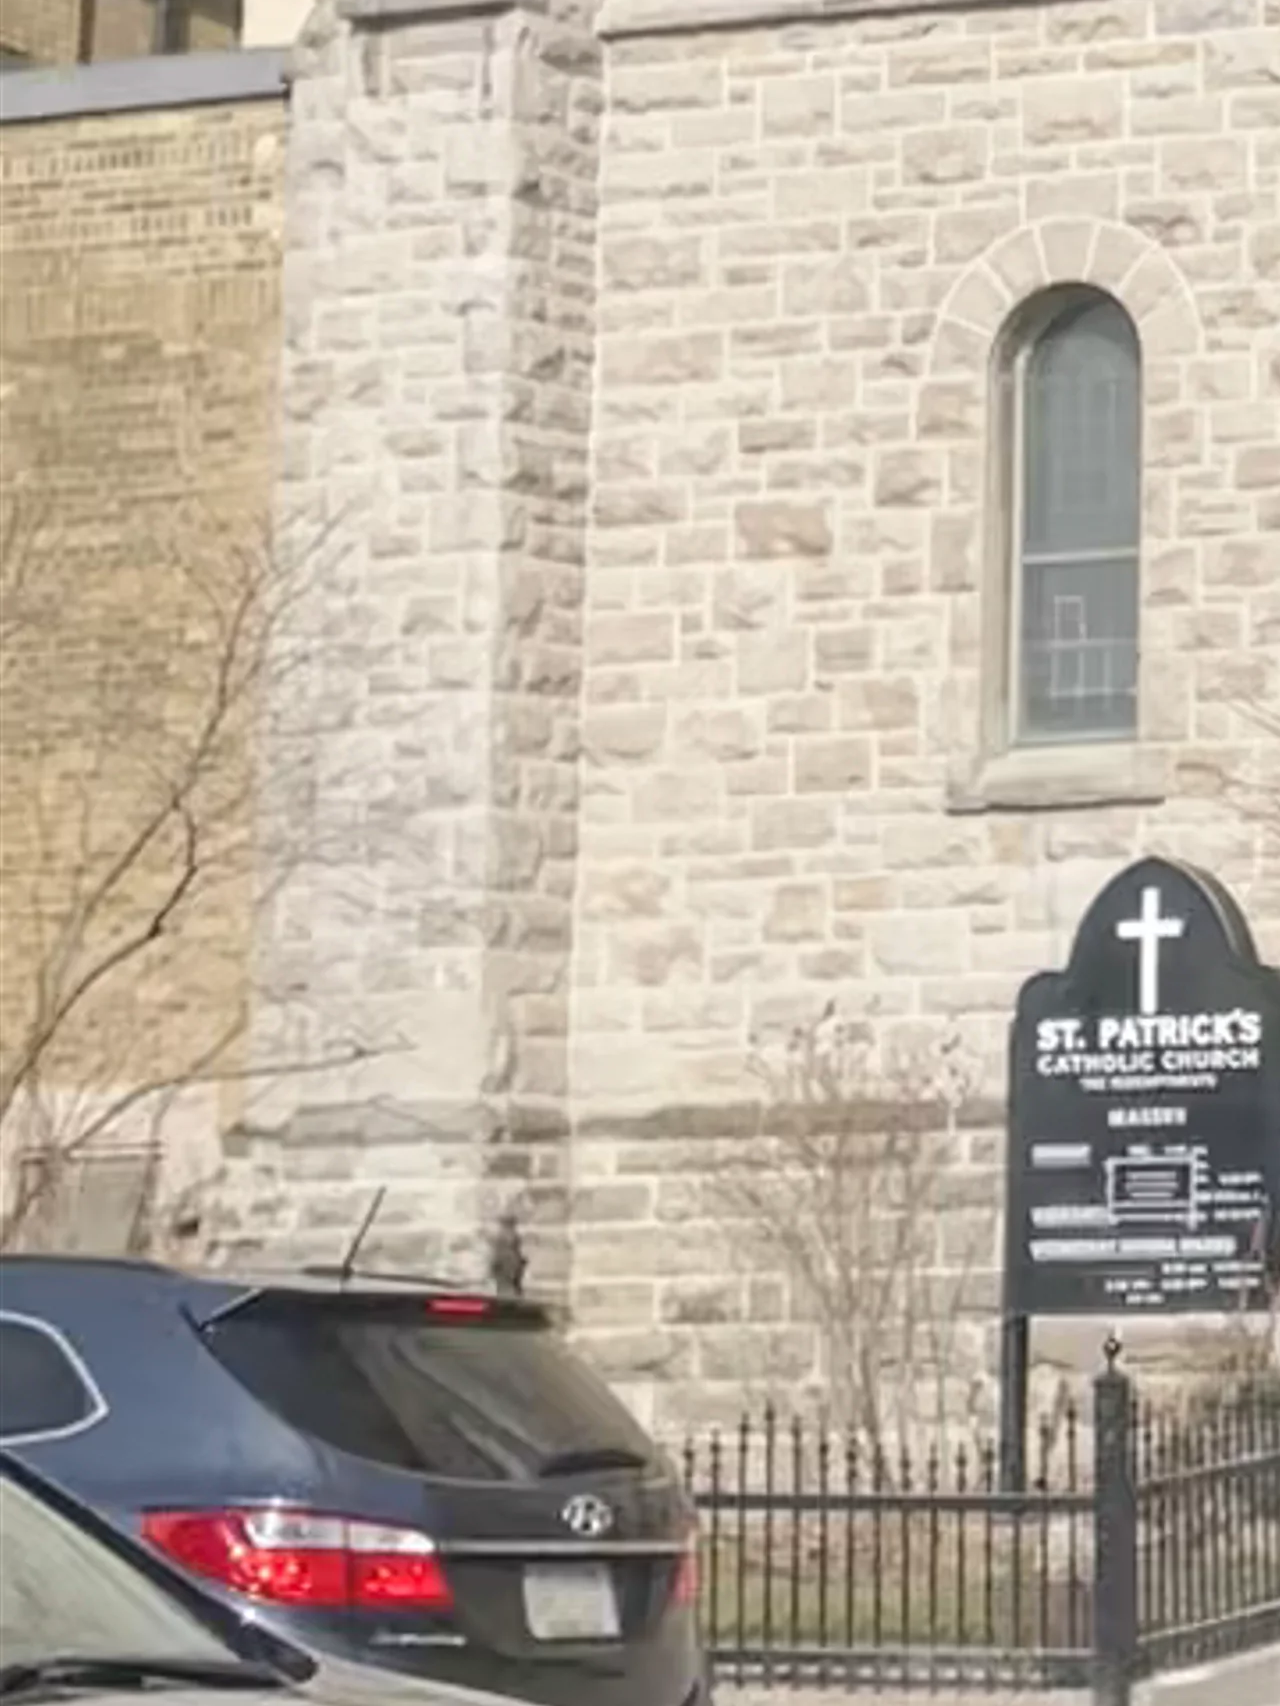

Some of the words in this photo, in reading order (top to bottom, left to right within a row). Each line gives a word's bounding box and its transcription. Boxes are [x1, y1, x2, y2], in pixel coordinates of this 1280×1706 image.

[1036, 1017, 1087, 1050] ST.
[1099, 1008, 1261, 1048] PATRICK'S
[1036, 1053, 1155, 1074] CATHOLIC
[1160, 1047, 1260, 1070] CHURCH
